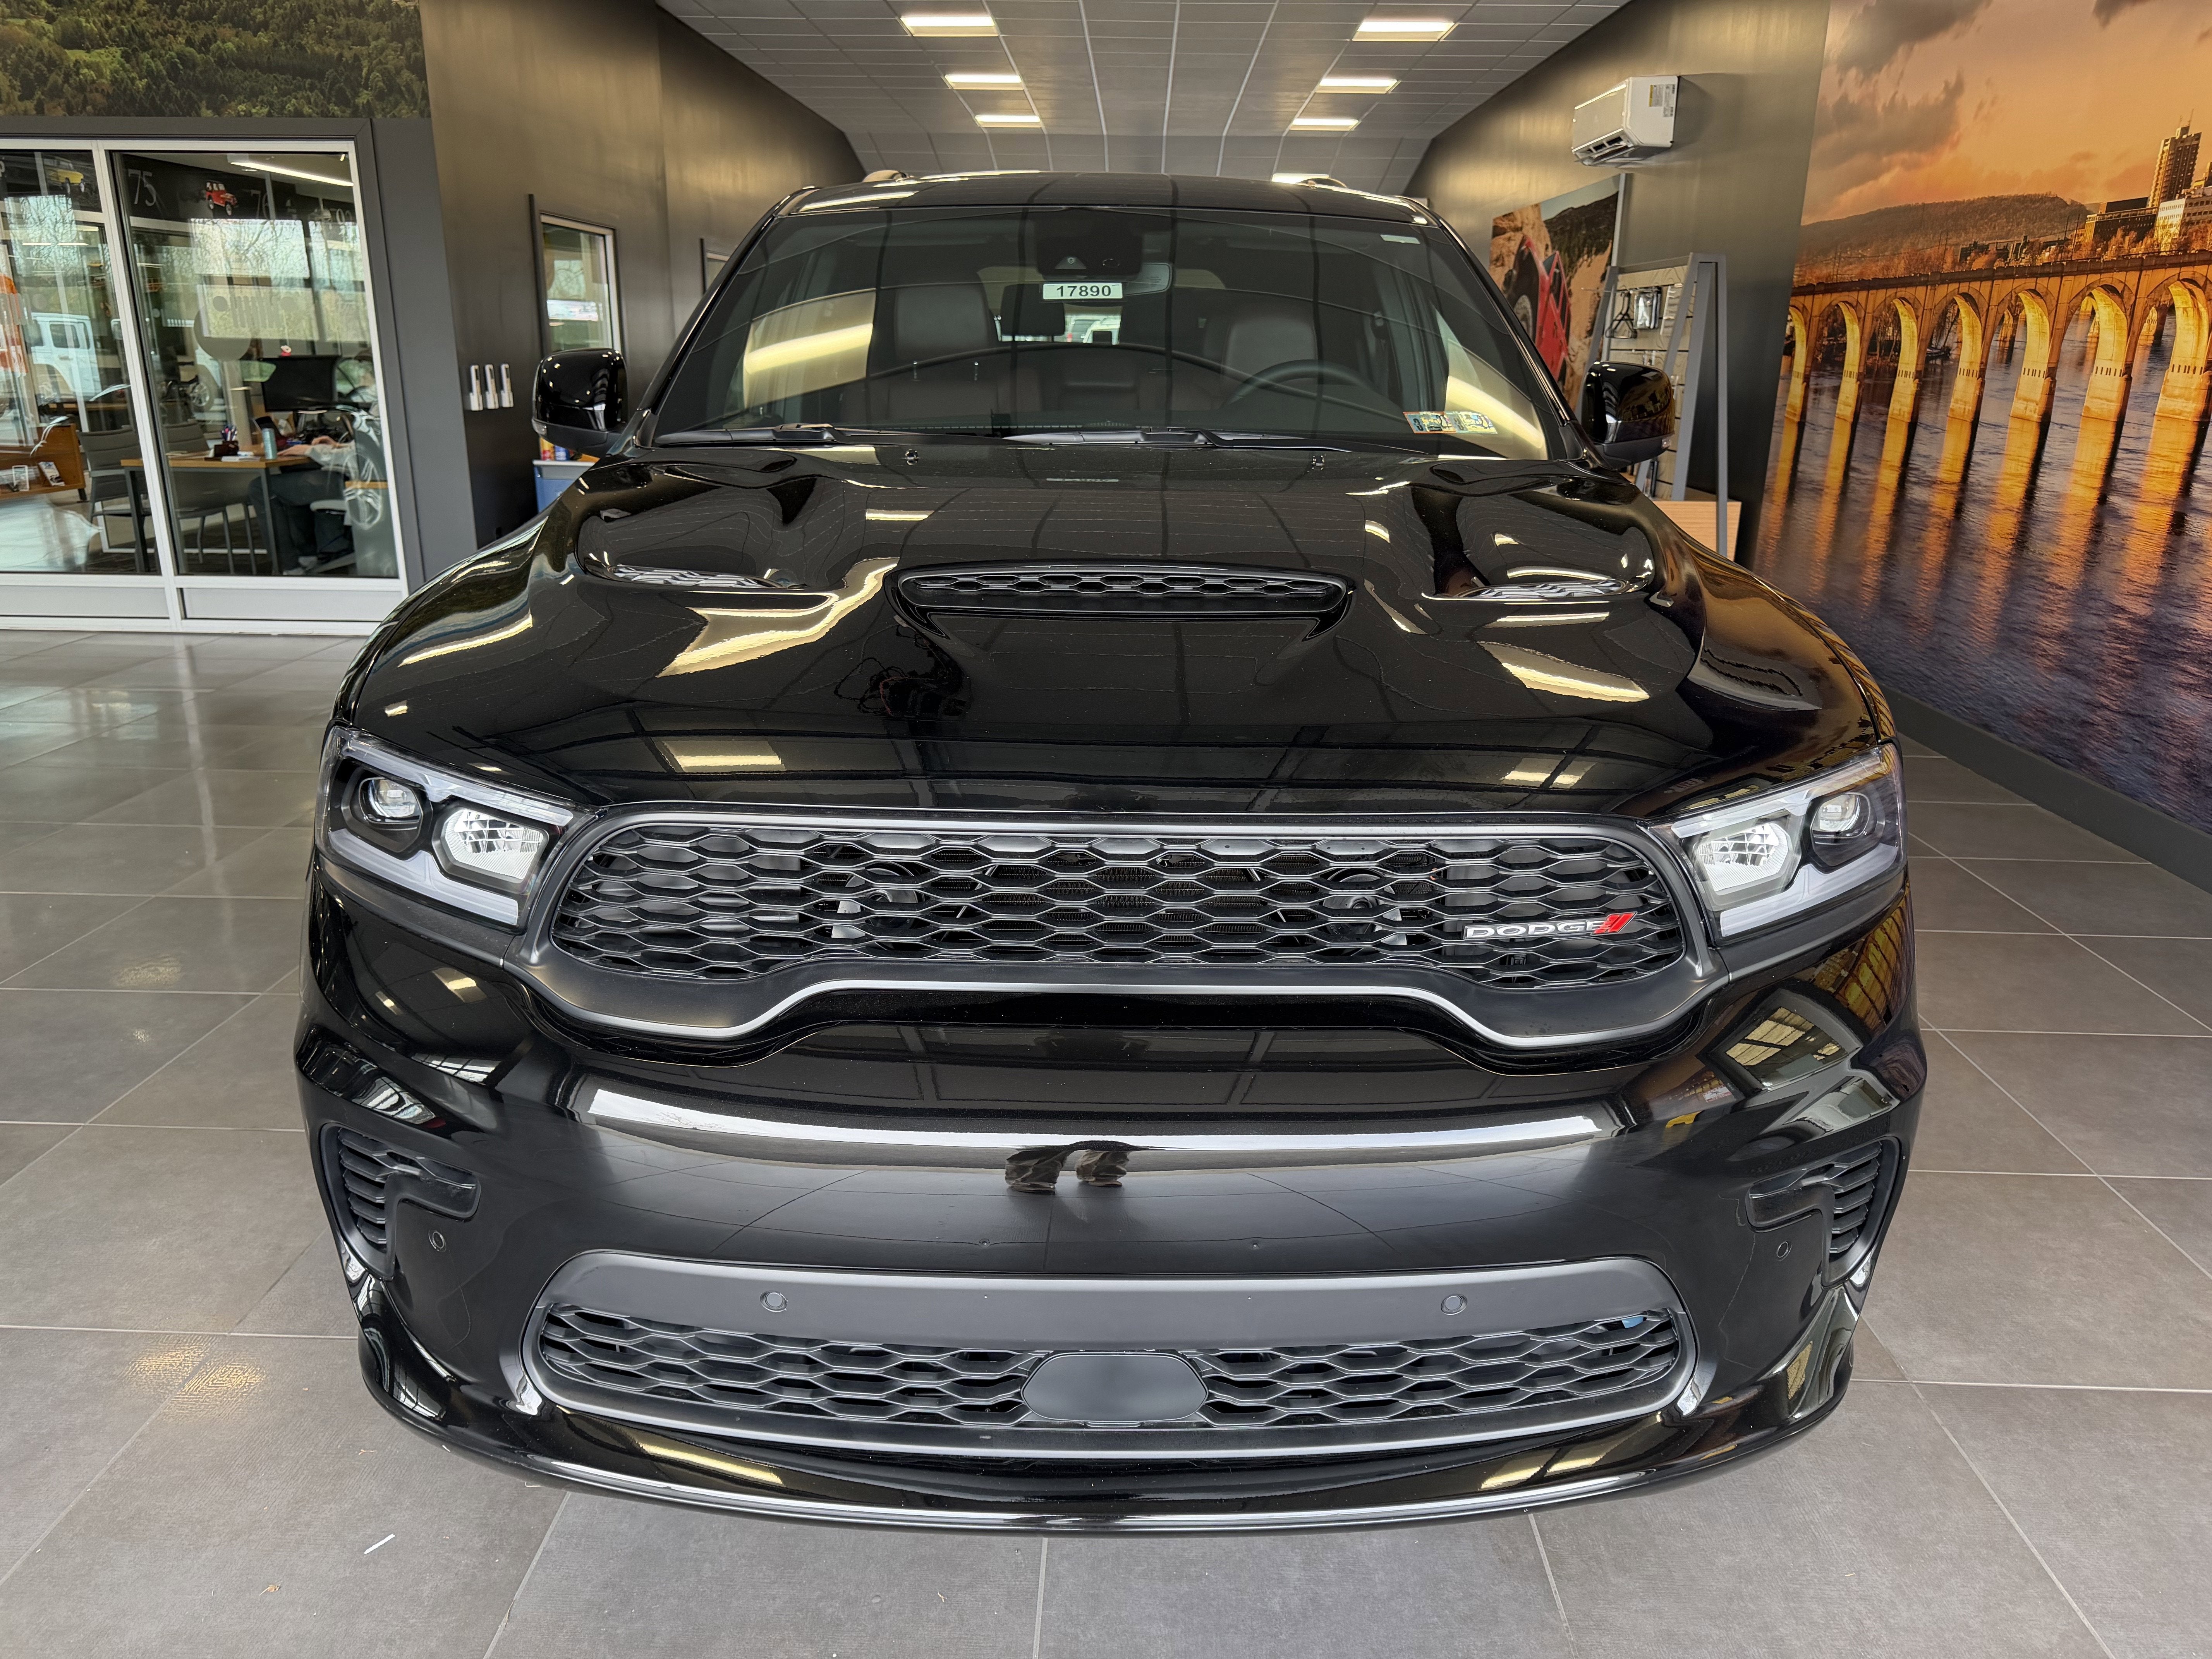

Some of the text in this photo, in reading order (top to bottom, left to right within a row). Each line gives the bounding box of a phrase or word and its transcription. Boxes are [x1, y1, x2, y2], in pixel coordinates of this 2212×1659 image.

[128, 168, 156, 206] 75
[1056, 285, 1111, 297] 17890
[1413, 418, 1424, 431] 3
[1467, 920, 1604, 938] DODGE
